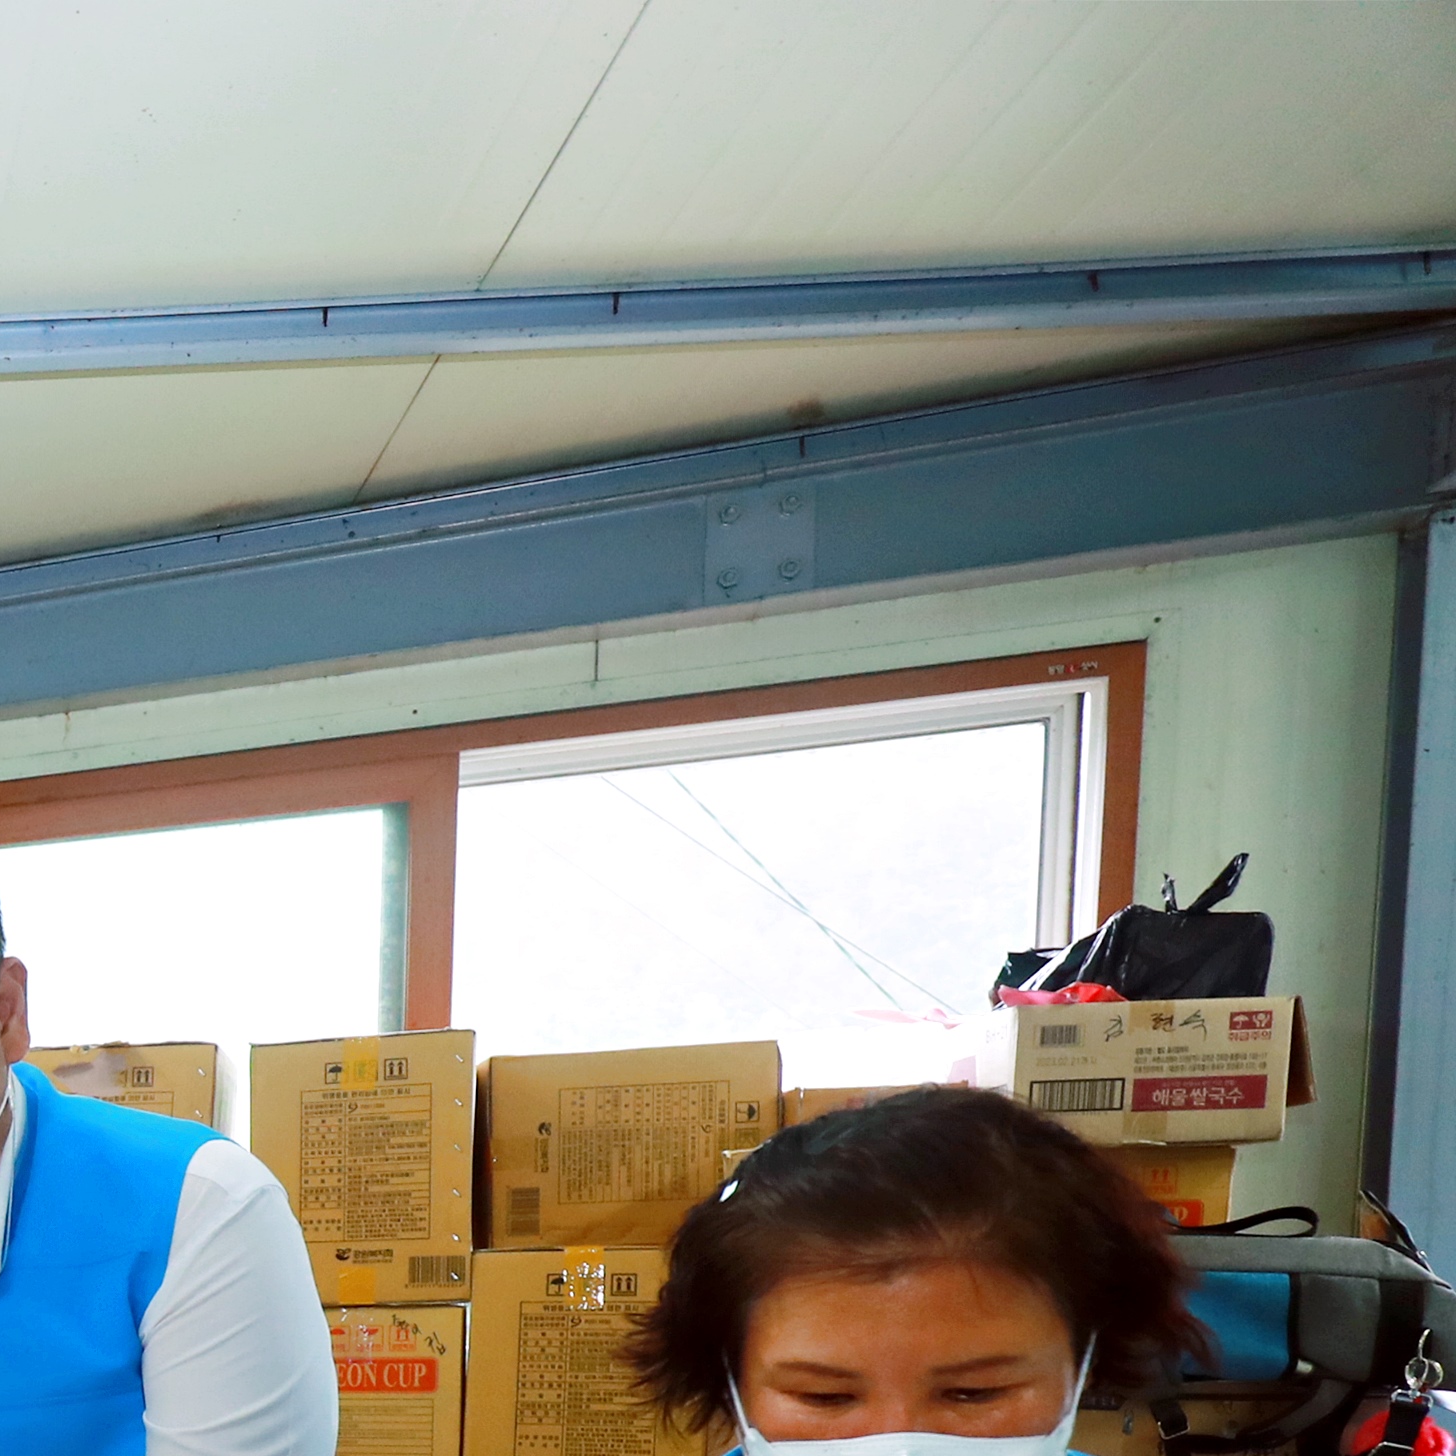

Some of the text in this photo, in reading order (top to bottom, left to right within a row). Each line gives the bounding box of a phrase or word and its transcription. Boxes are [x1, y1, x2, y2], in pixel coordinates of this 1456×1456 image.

[1228, 1030, 1273, 1042] 취급주의
[1151, 1086, 1245, 1107] 해물쌀국수
[382, 1362, 428, 1388] CUP
